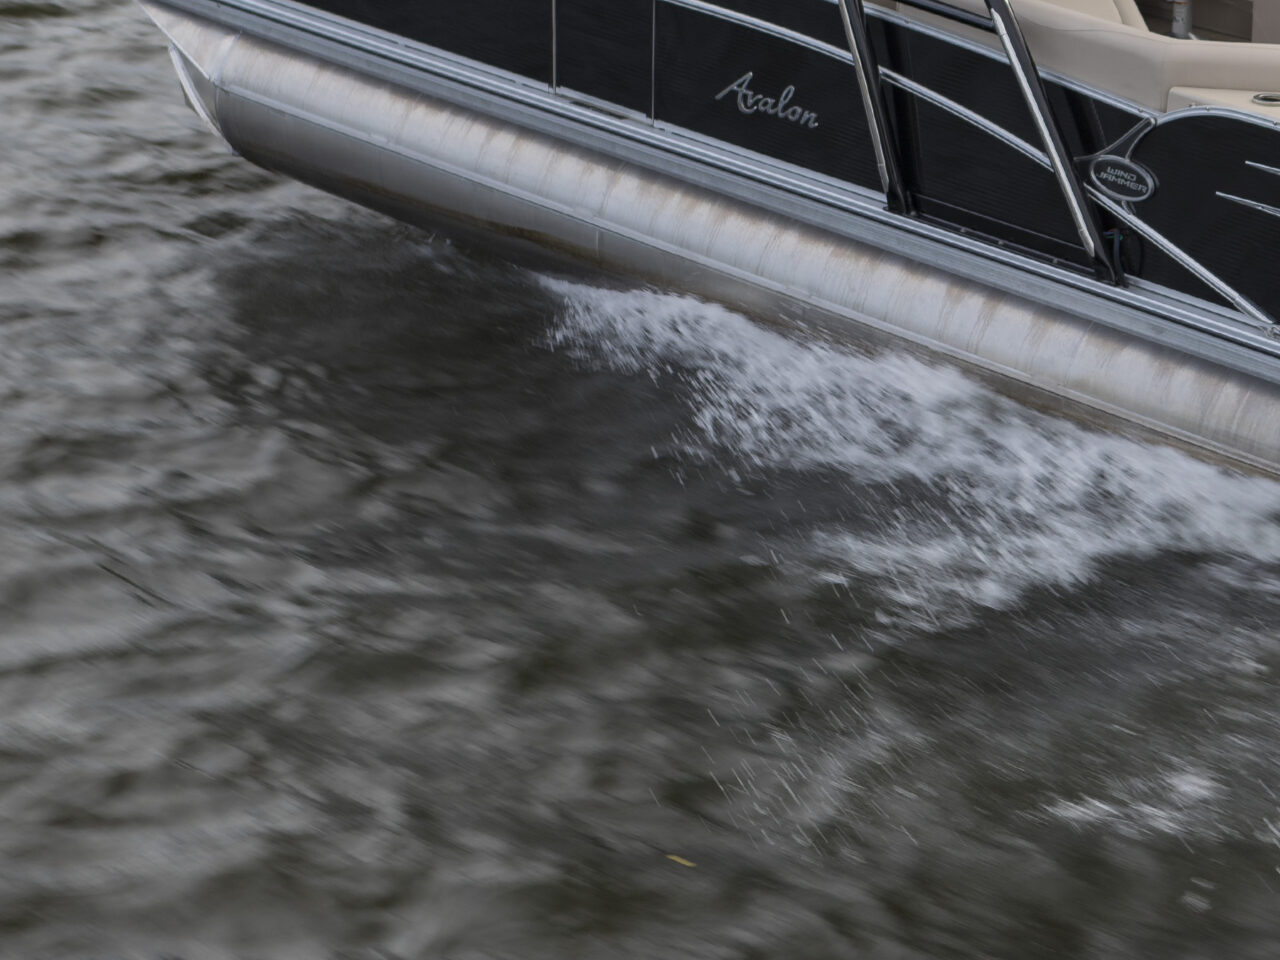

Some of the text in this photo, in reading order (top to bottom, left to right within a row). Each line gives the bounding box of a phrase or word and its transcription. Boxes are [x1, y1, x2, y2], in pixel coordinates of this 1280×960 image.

[714, 71, 819, 128] Avalon
[1097, 171, 1148, 193] JAMMER
[1107, 166, 1137, 181] WIND
